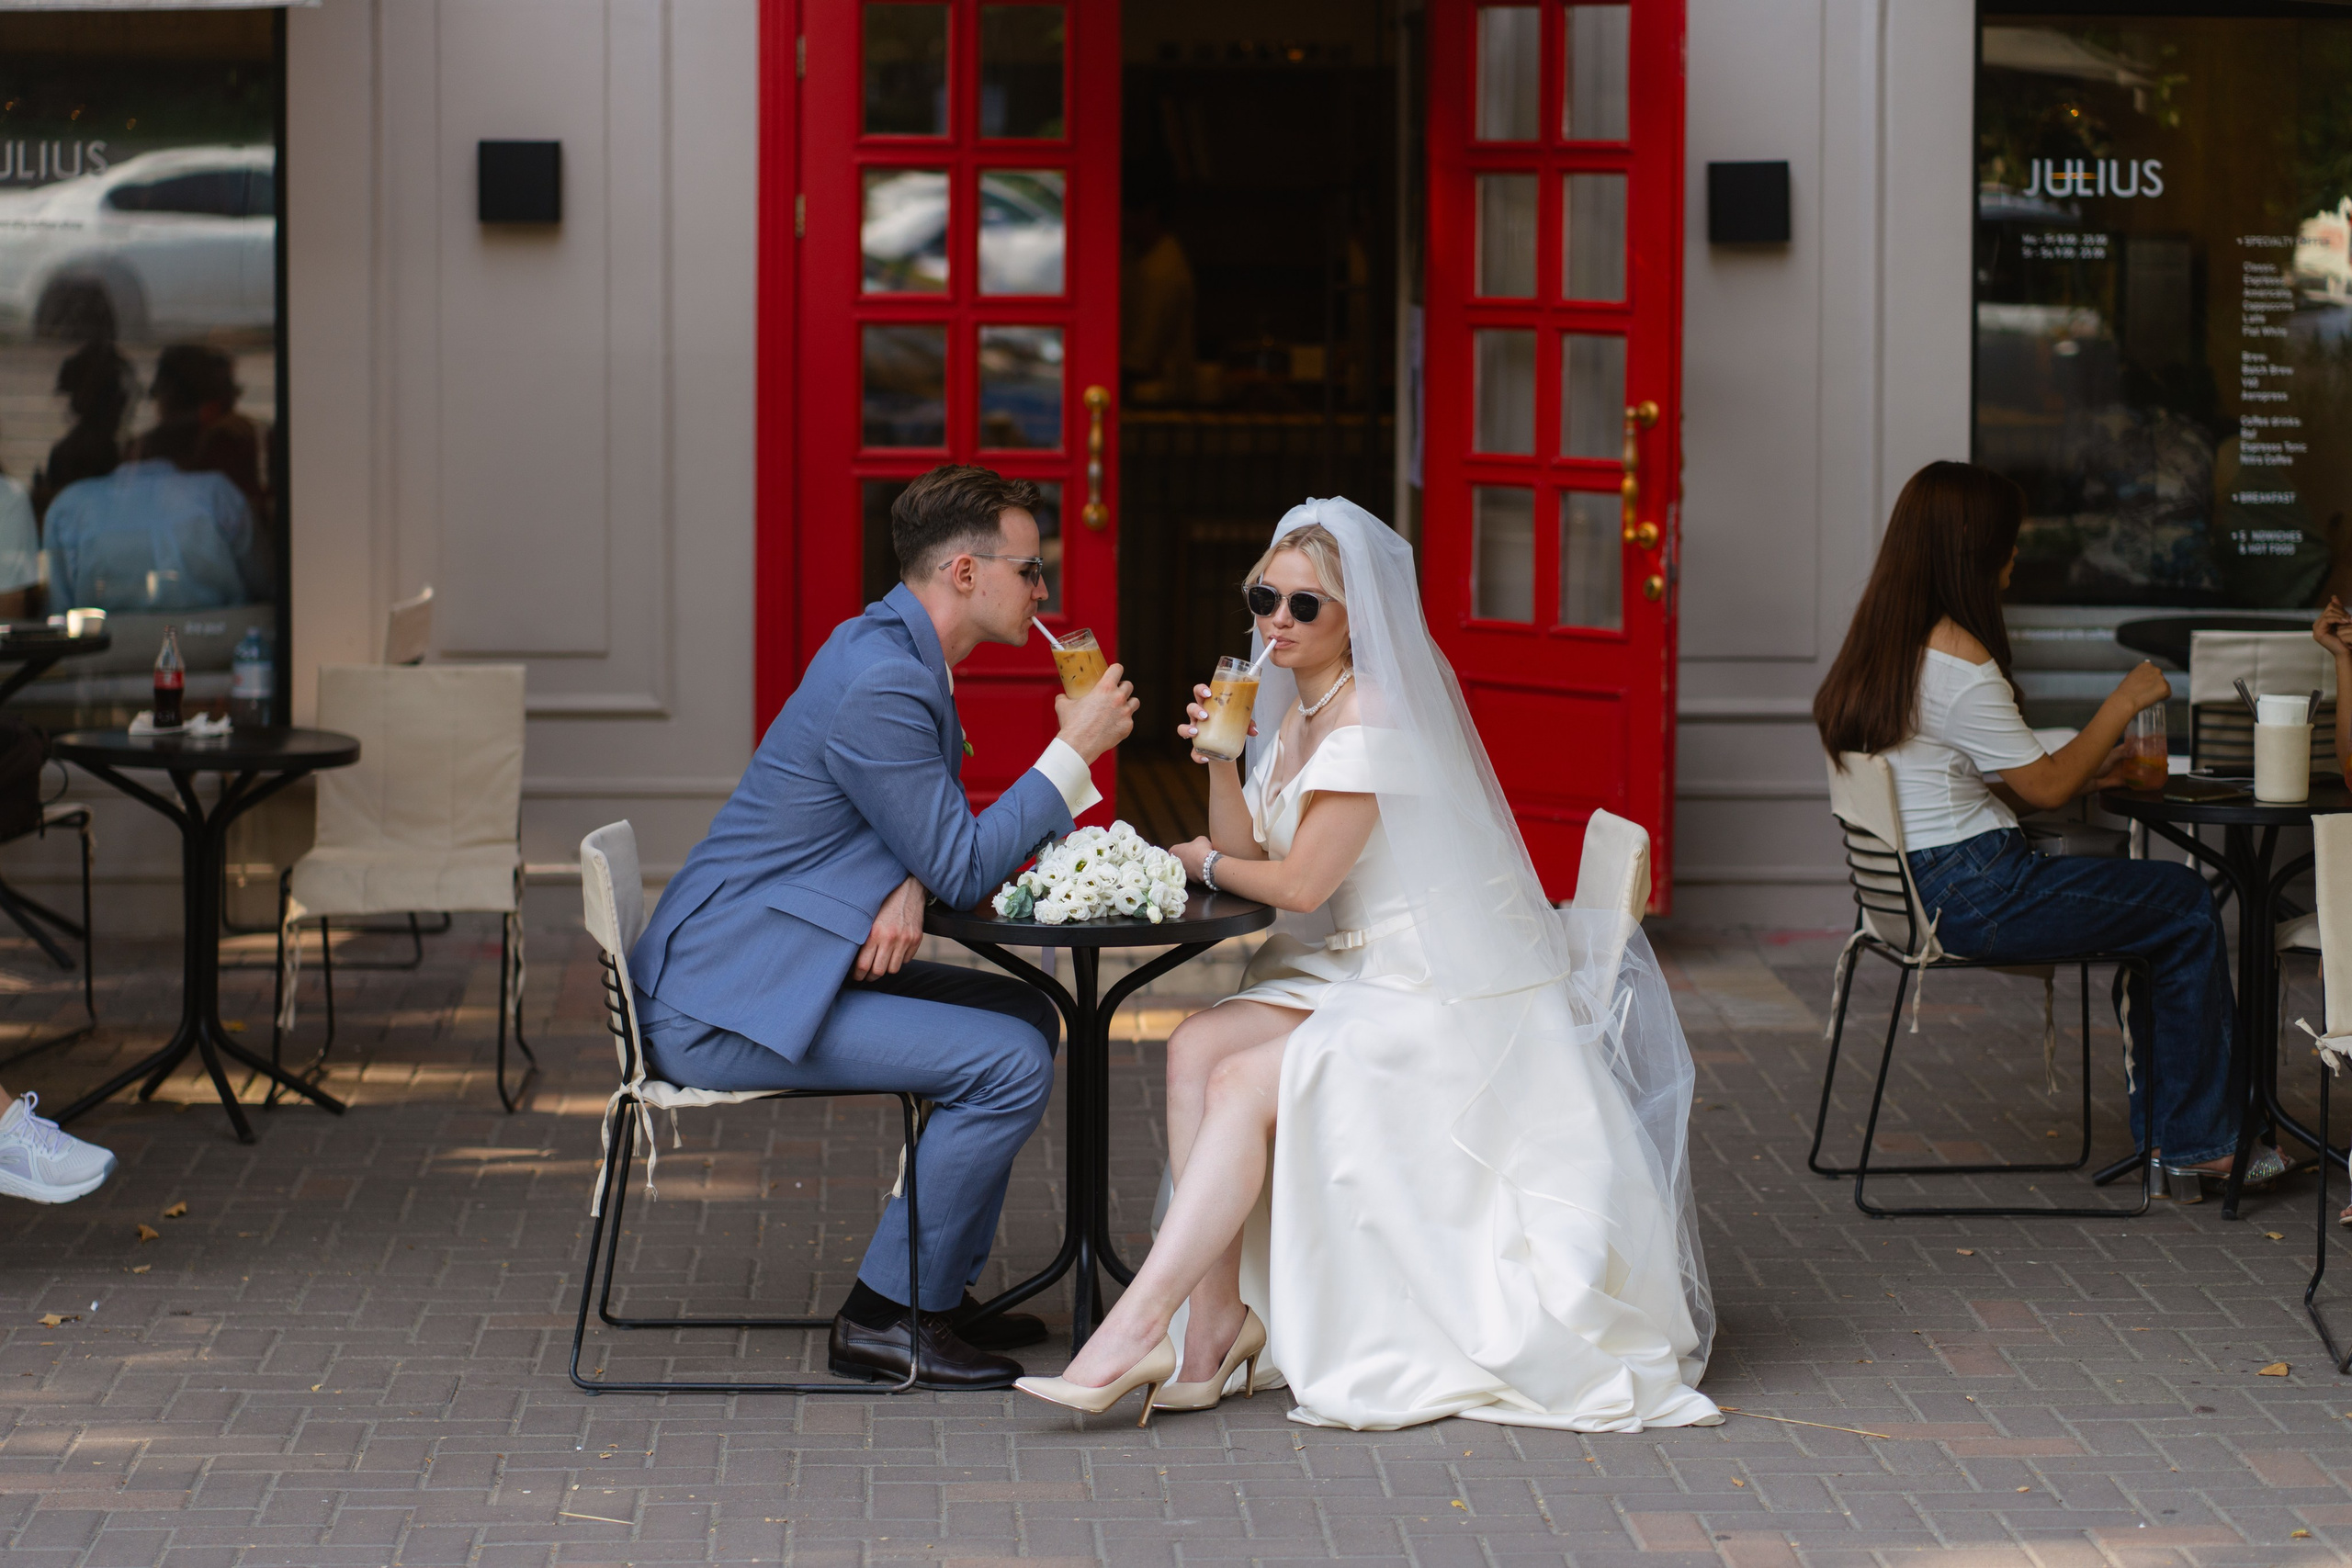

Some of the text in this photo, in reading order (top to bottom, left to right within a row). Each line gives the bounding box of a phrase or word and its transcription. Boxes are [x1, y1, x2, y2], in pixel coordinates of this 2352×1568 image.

[2023, 158, 2165, 198] JULIUS
[2262, 326, 2289, 337] White
[2241, 415, 2269, 427] Coffee
[2241, 441, 2308, 454] Espresso Tonic
[2265, 454, 2293, 466] Coffee
[2240, 491, 2297, 504] BREAKFAST
[2249, 544, 2267, 556] HOT
[2269, 544, 2297, 556] FOOD
